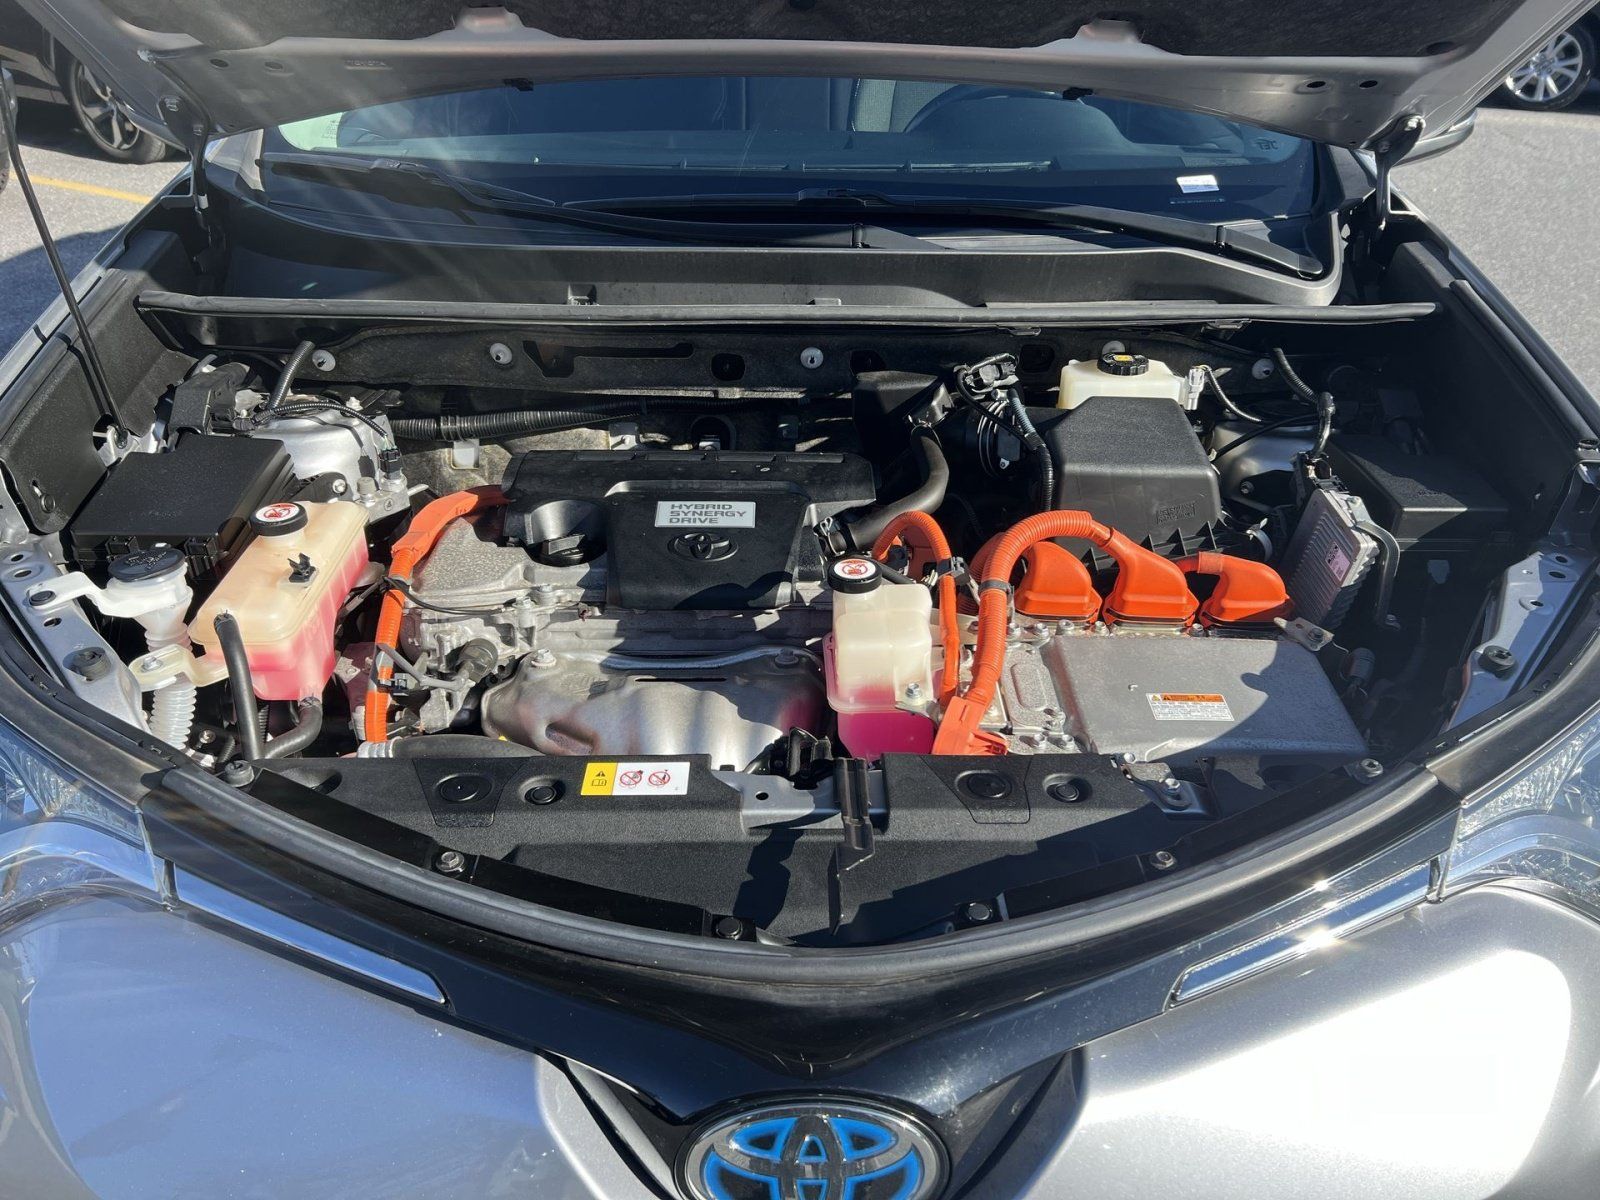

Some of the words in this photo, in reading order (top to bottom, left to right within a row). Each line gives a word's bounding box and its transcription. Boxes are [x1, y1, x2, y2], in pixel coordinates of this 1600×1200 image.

[670, 503, 733, 511] HYBRID
[669, 510, 747, 518] SYNERGY
[668, 517, 720, 525] DRIVE
